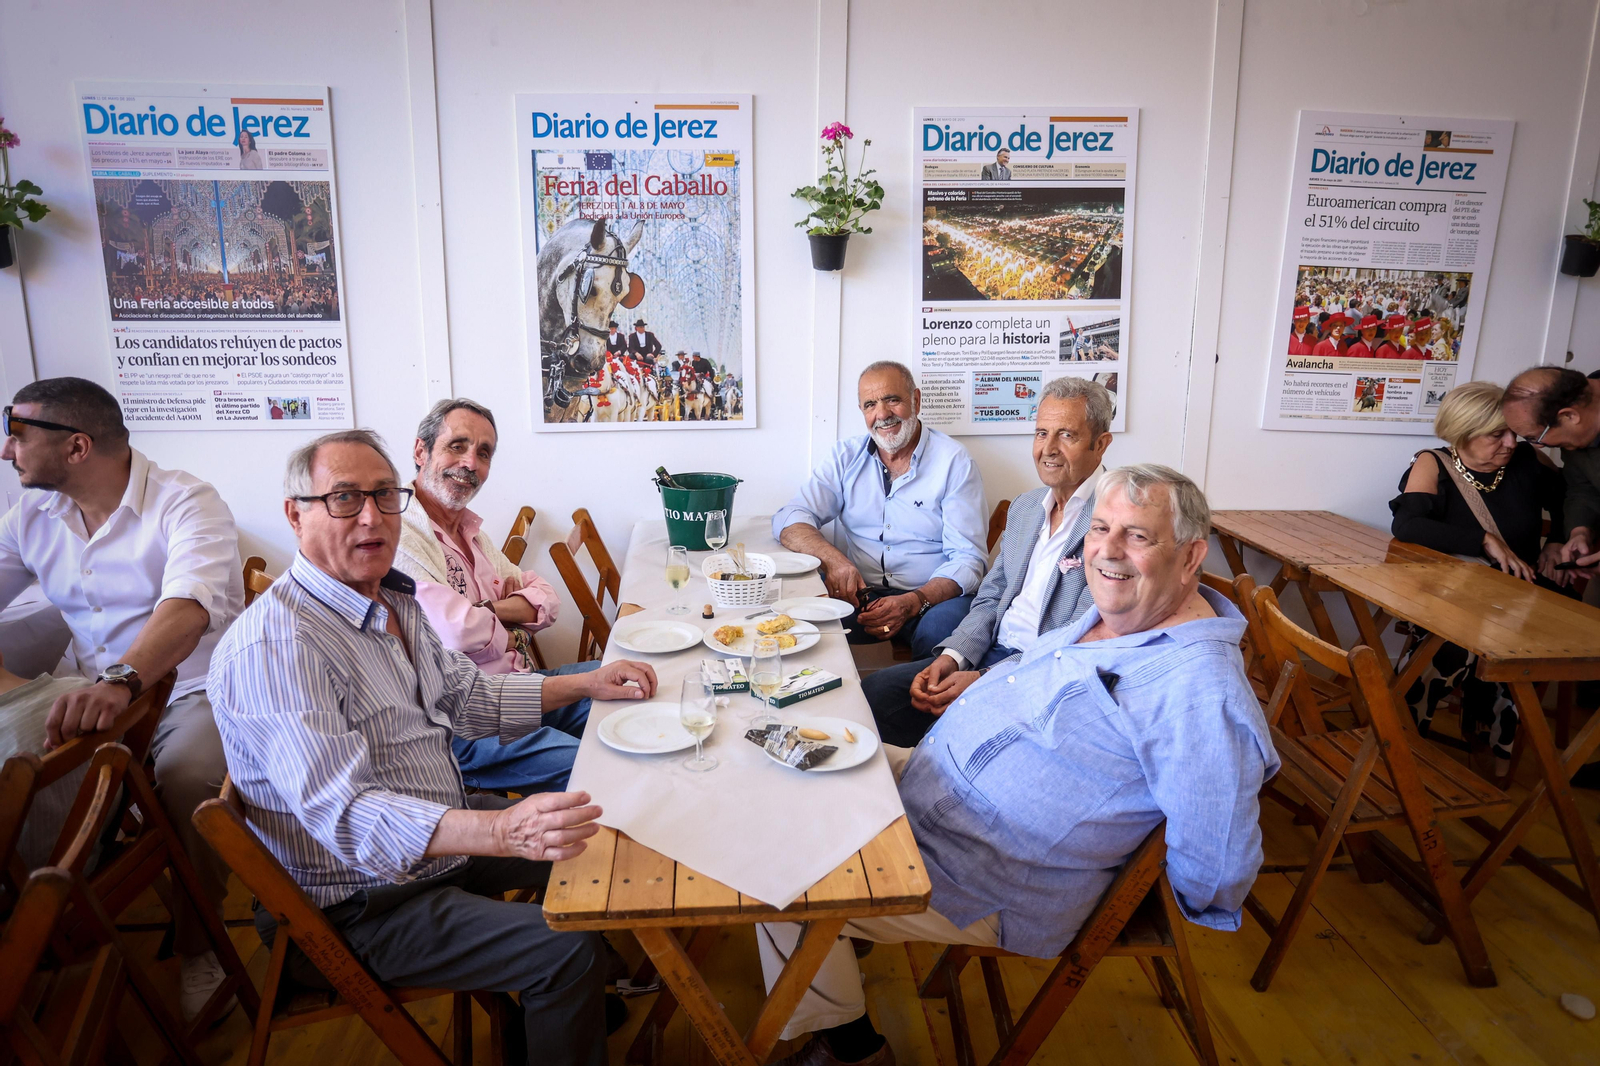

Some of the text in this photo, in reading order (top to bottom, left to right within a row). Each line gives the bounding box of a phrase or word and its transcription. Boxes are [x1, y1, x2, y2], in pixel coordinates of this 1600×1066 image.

[83, 104, 310, 146] Diario de Jerez
[532, 112, 717, 146] Diario de Jerez
[923, 124, 1113, 160] Diario de Jerez
[1311, 149, 1477, 186] Diario de Jerez
[543, 174, 727, 196] Feria del Caballo
[579, 202, 601, 211] JEREZ
[1307, 194, 1446, 215] Euroamerican compra
[656, 212, 685, 221] Europea
[1305, 214, 1420, 232] el 51% del circuito
[114, 300, 138, 309] Una
[141, 299, 170, 309] Feria
[174, 299, 229, 309] accesible
[242, 299, 274, 309] todos
[923, 317, 1050, 331] Lorenzo completa un
[115, 335, 342, 352] Los candidatos rehúyen de pactos
[923, 332, 1050, 348] pleno para la historia
[117, 352, 337, 369] y confían en mejorar los sondeos
[1286, 359, 1333, 369] Avalancha
[665, 508, 680, 520] TIO
[808, 686, 824, 695] MATEO
[353, 971, 377, 995] RUIZ
